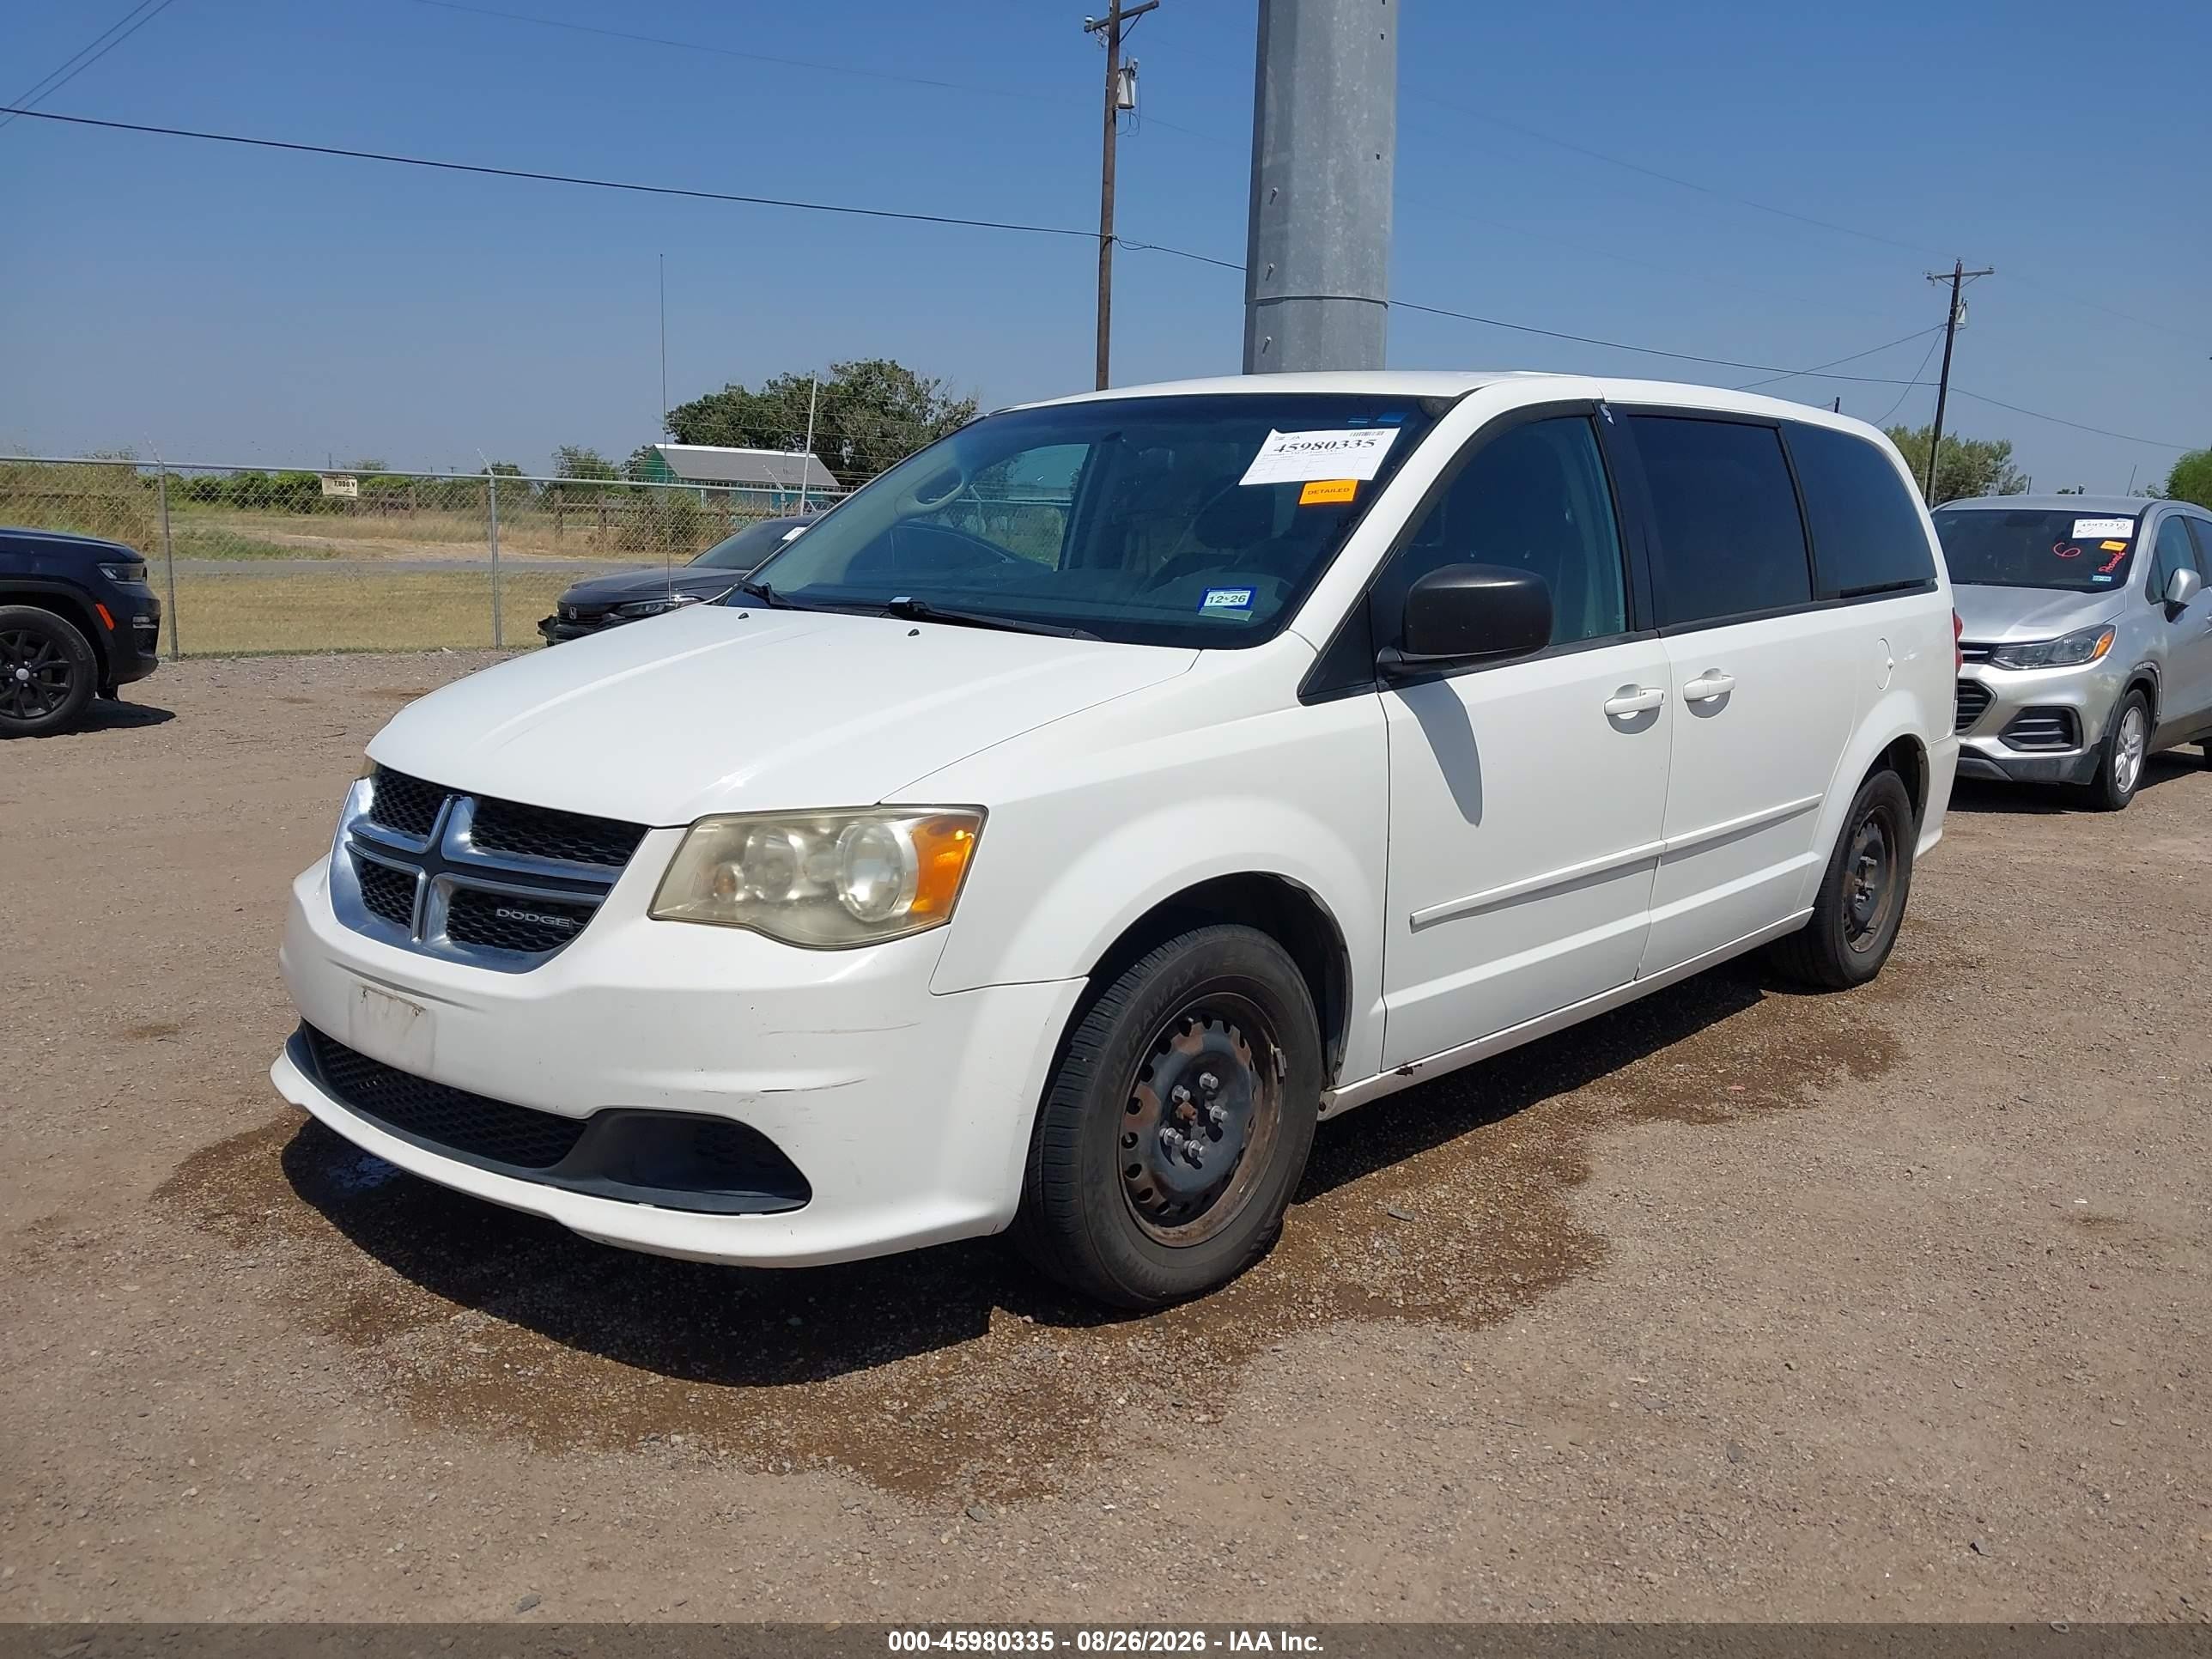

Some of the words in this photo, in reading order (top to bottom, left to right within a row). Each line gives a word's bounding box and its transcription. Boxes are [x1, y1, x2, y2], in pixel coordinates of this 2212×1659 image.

[1273, 438, 1377, 453] 45980335
[1307, 486, 1351, 495] DETAILED
[496, 908, 571, 928] DODGE
